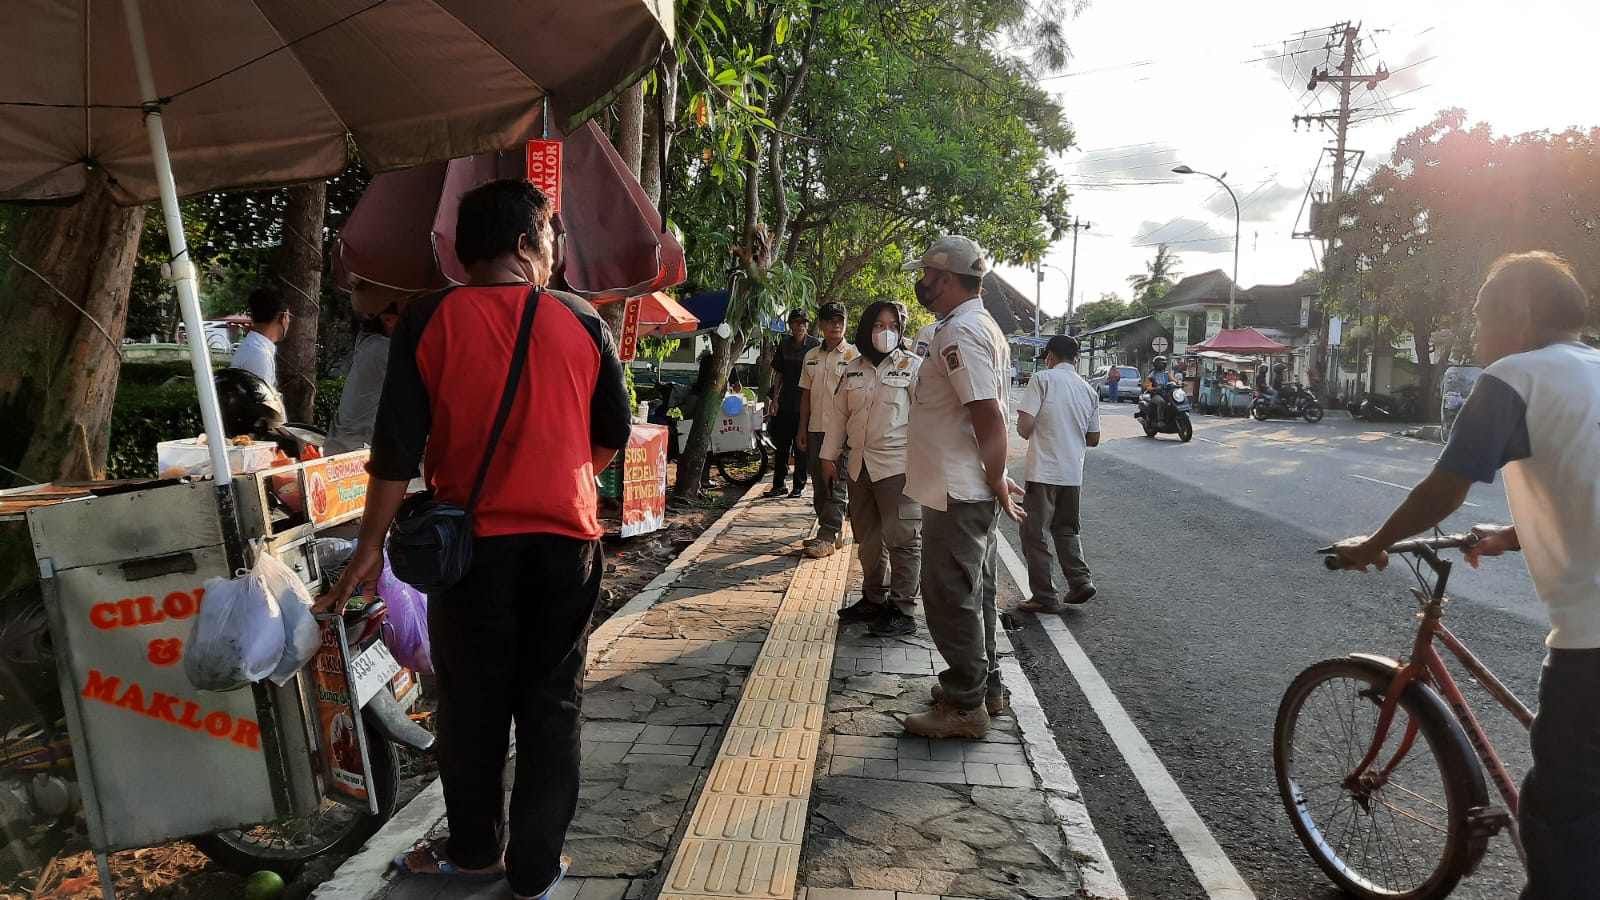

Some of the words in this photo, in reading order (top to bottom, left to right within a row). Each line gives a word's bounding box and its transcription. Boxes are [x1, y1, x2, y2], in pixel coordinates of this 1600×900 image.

[532, 151, 544, 190] ILOR
[625, 304, 636, 356] CIMOL
[147, 636, 183, 667] &
[81, 669, 261, 750] MAKLOR
